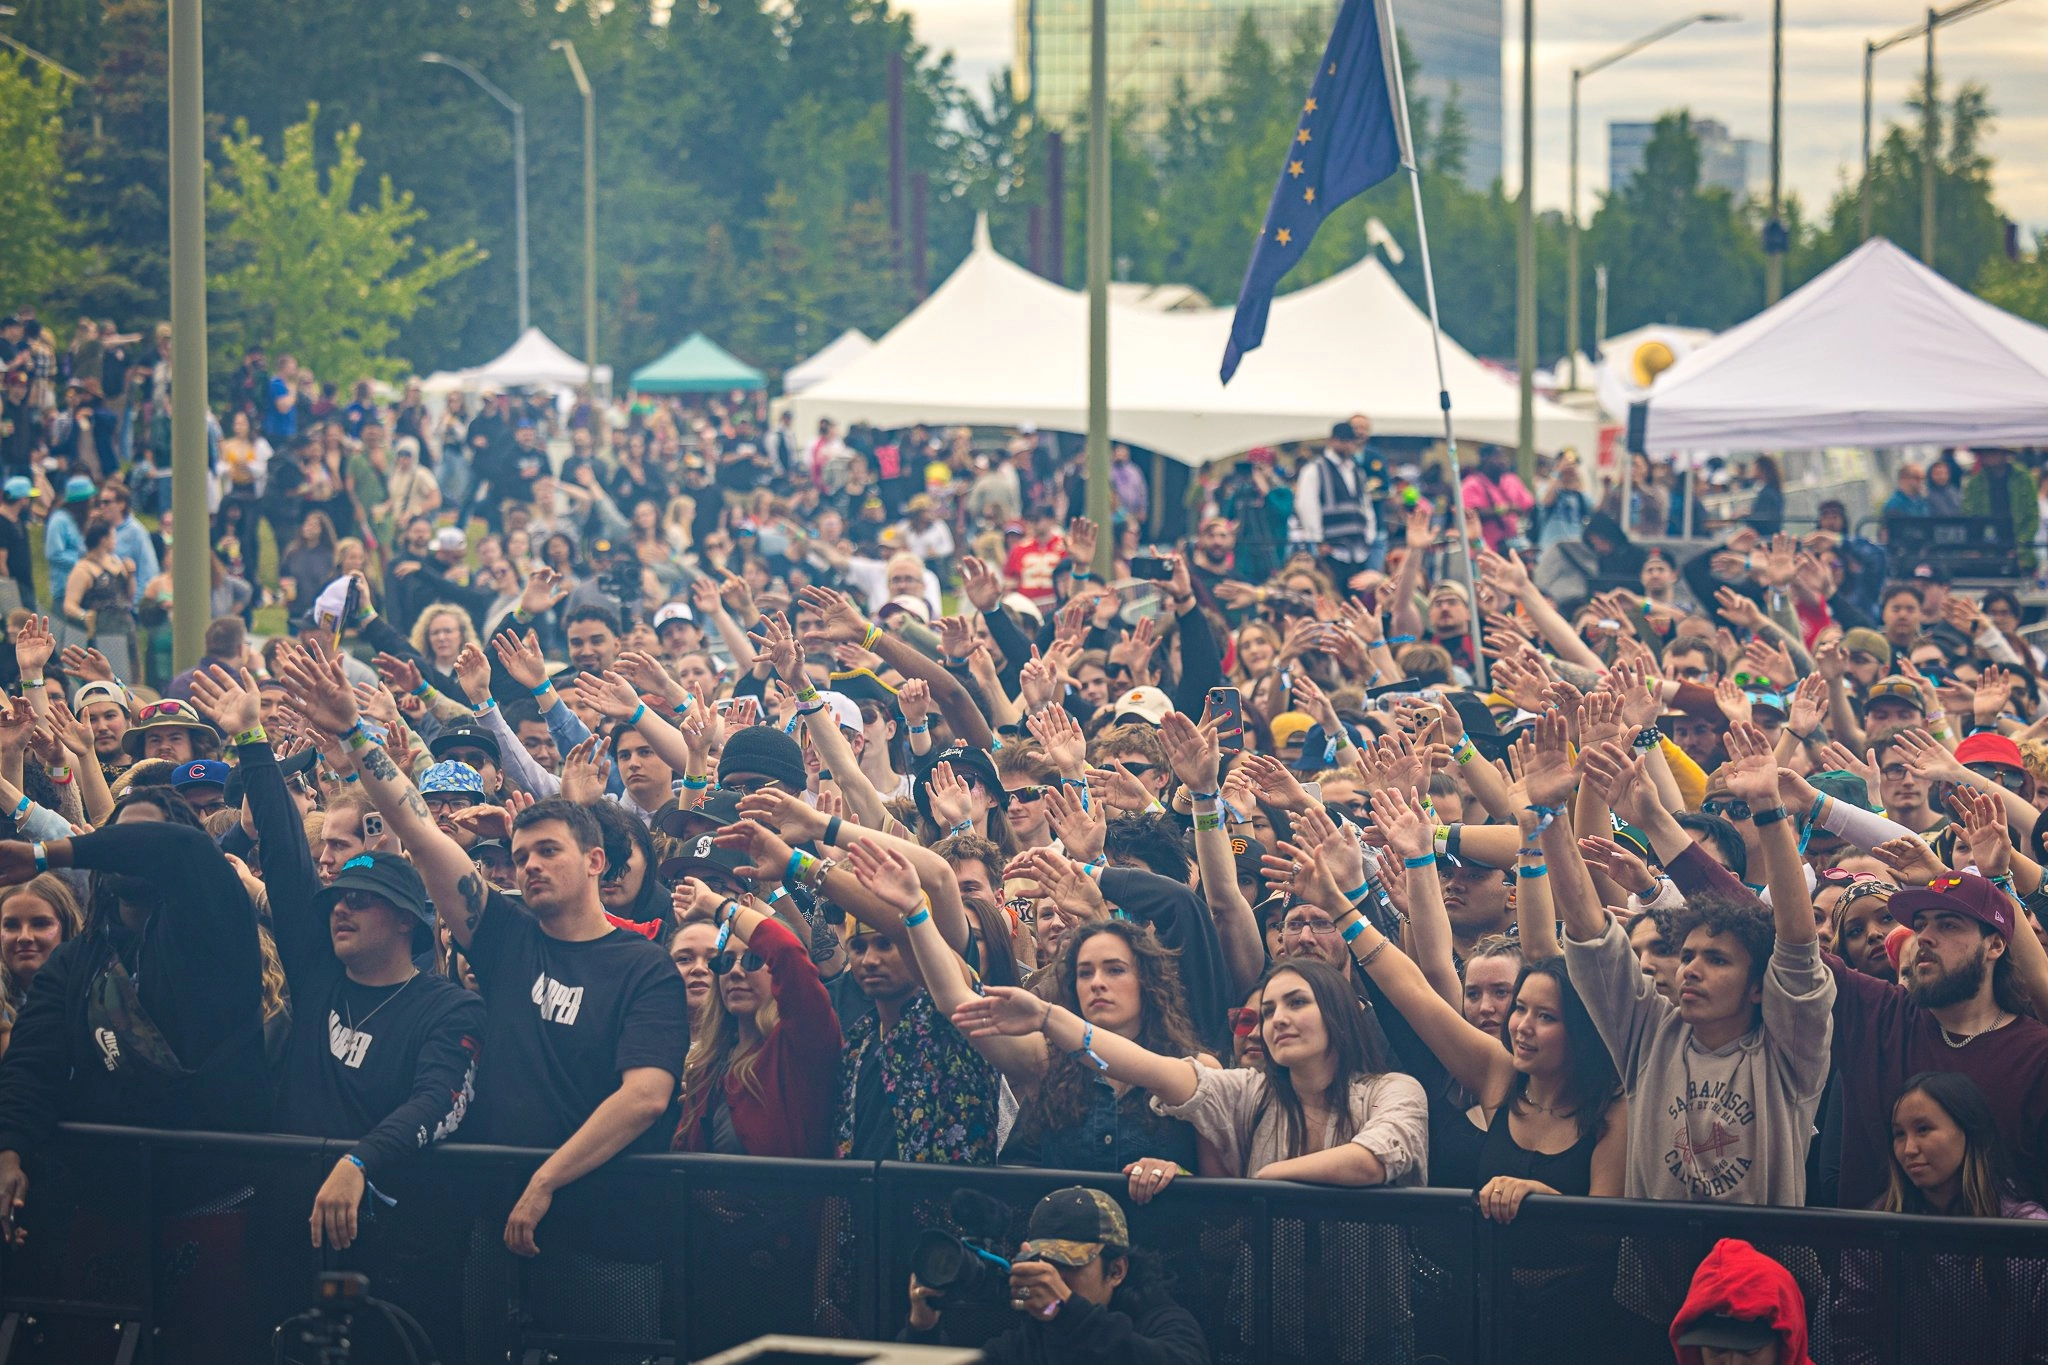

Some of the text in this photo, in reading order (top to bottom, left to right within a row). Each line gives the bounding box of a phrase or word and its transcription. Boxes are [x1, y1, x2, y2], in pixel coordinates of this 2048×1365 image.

[189, 764, 205, 779] C
[103, 1031, 120, 1057] NIKE
[1668, 1081, 1755, 1126] SA RANISCO
[1711, 1102, 1722, 1115] HE
